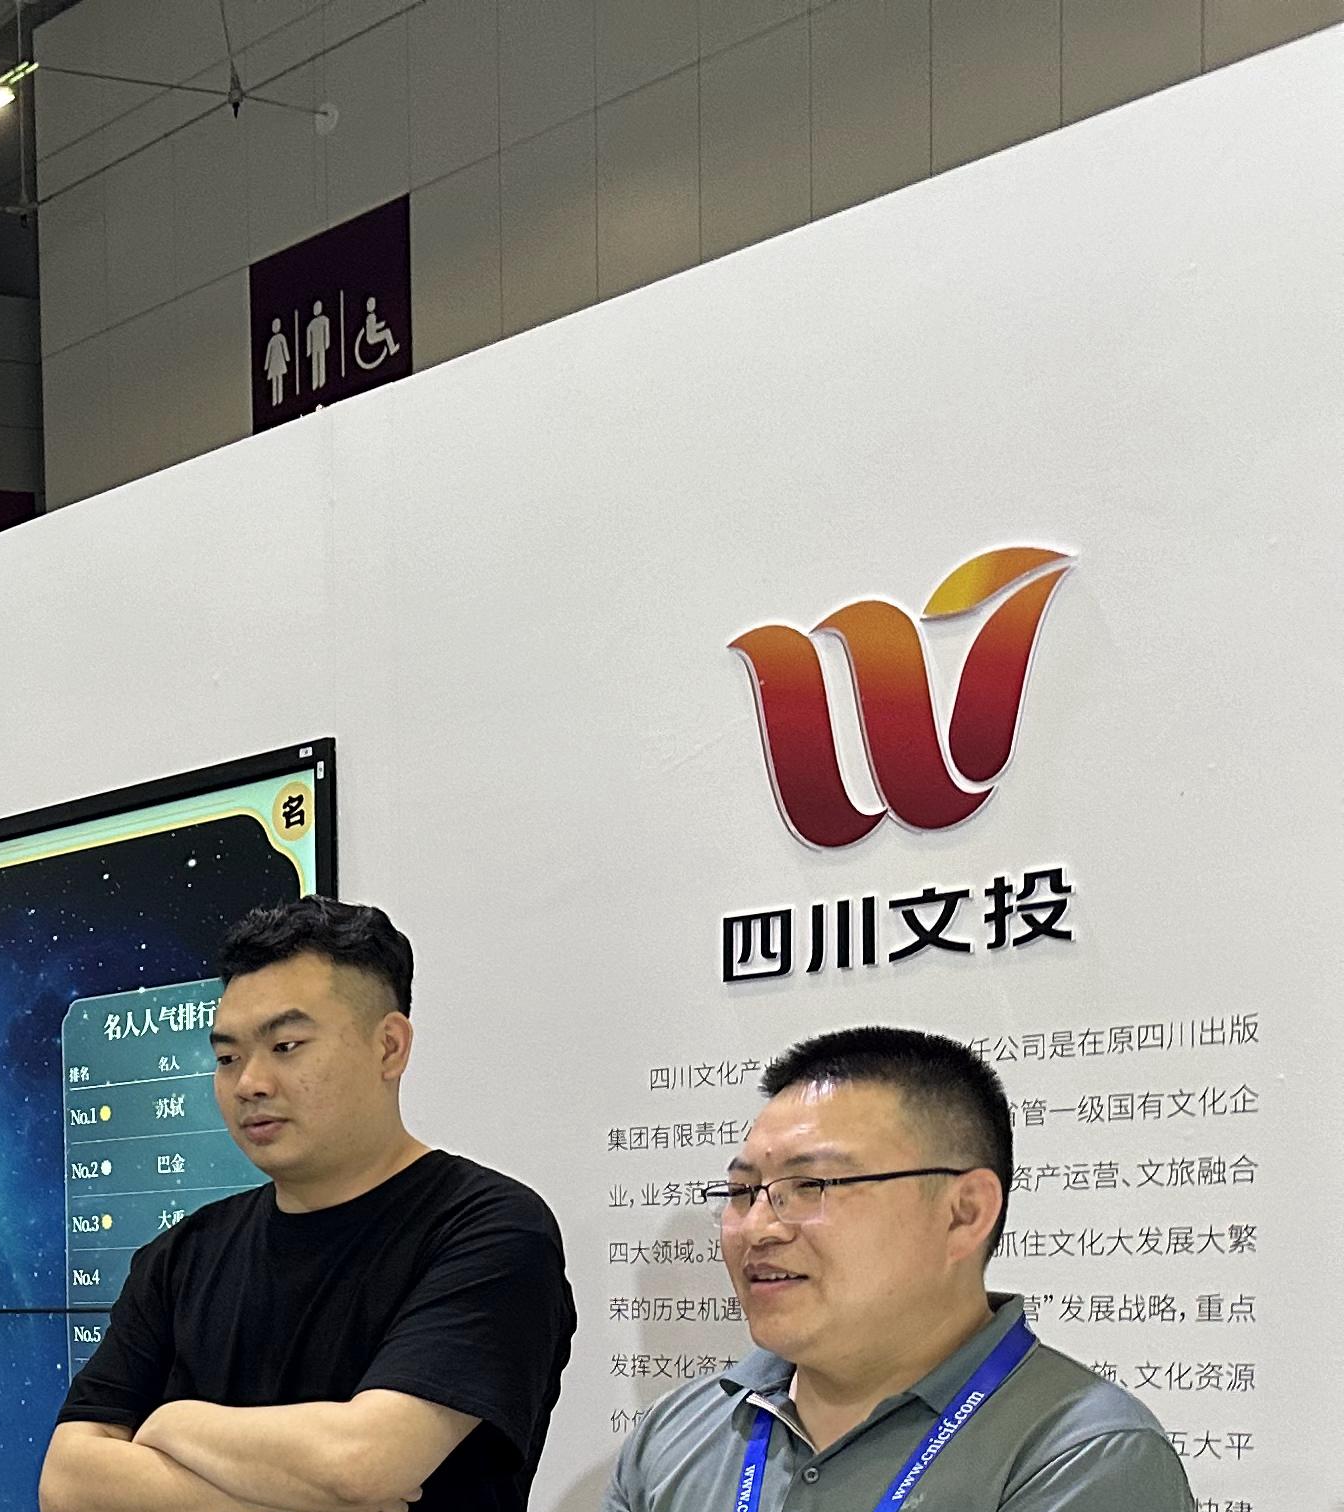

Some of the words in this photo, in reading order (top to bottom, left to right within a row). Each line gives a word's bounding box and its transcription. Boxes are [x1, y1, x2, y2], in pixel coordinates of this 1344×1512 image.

[282, 794, 306, 829] 名
[722, 866, 1074, 985] 四川文投
[104, 998, 222, 1041] 名人人气排行
[69, 1066, 90, 1083] 排名
[158, 1055, 181, 1072] 名人
[70, 1107, 98, 1125] No.1
[154, 1096, 186, 1120] 苏轼
[72, 1161, 100, 1180] No.2
[157, 1153, 186, 1174] 巴金
[72, 1215, 100, 1233] No.3
[72, 1269, 101, 1286] No.4
[609, 1297, 750, 1322] 荣的历史机遇
[73, 1326, 102, 1343] No.5
[891, 1391, 985, 1502] www.cnicif.com
